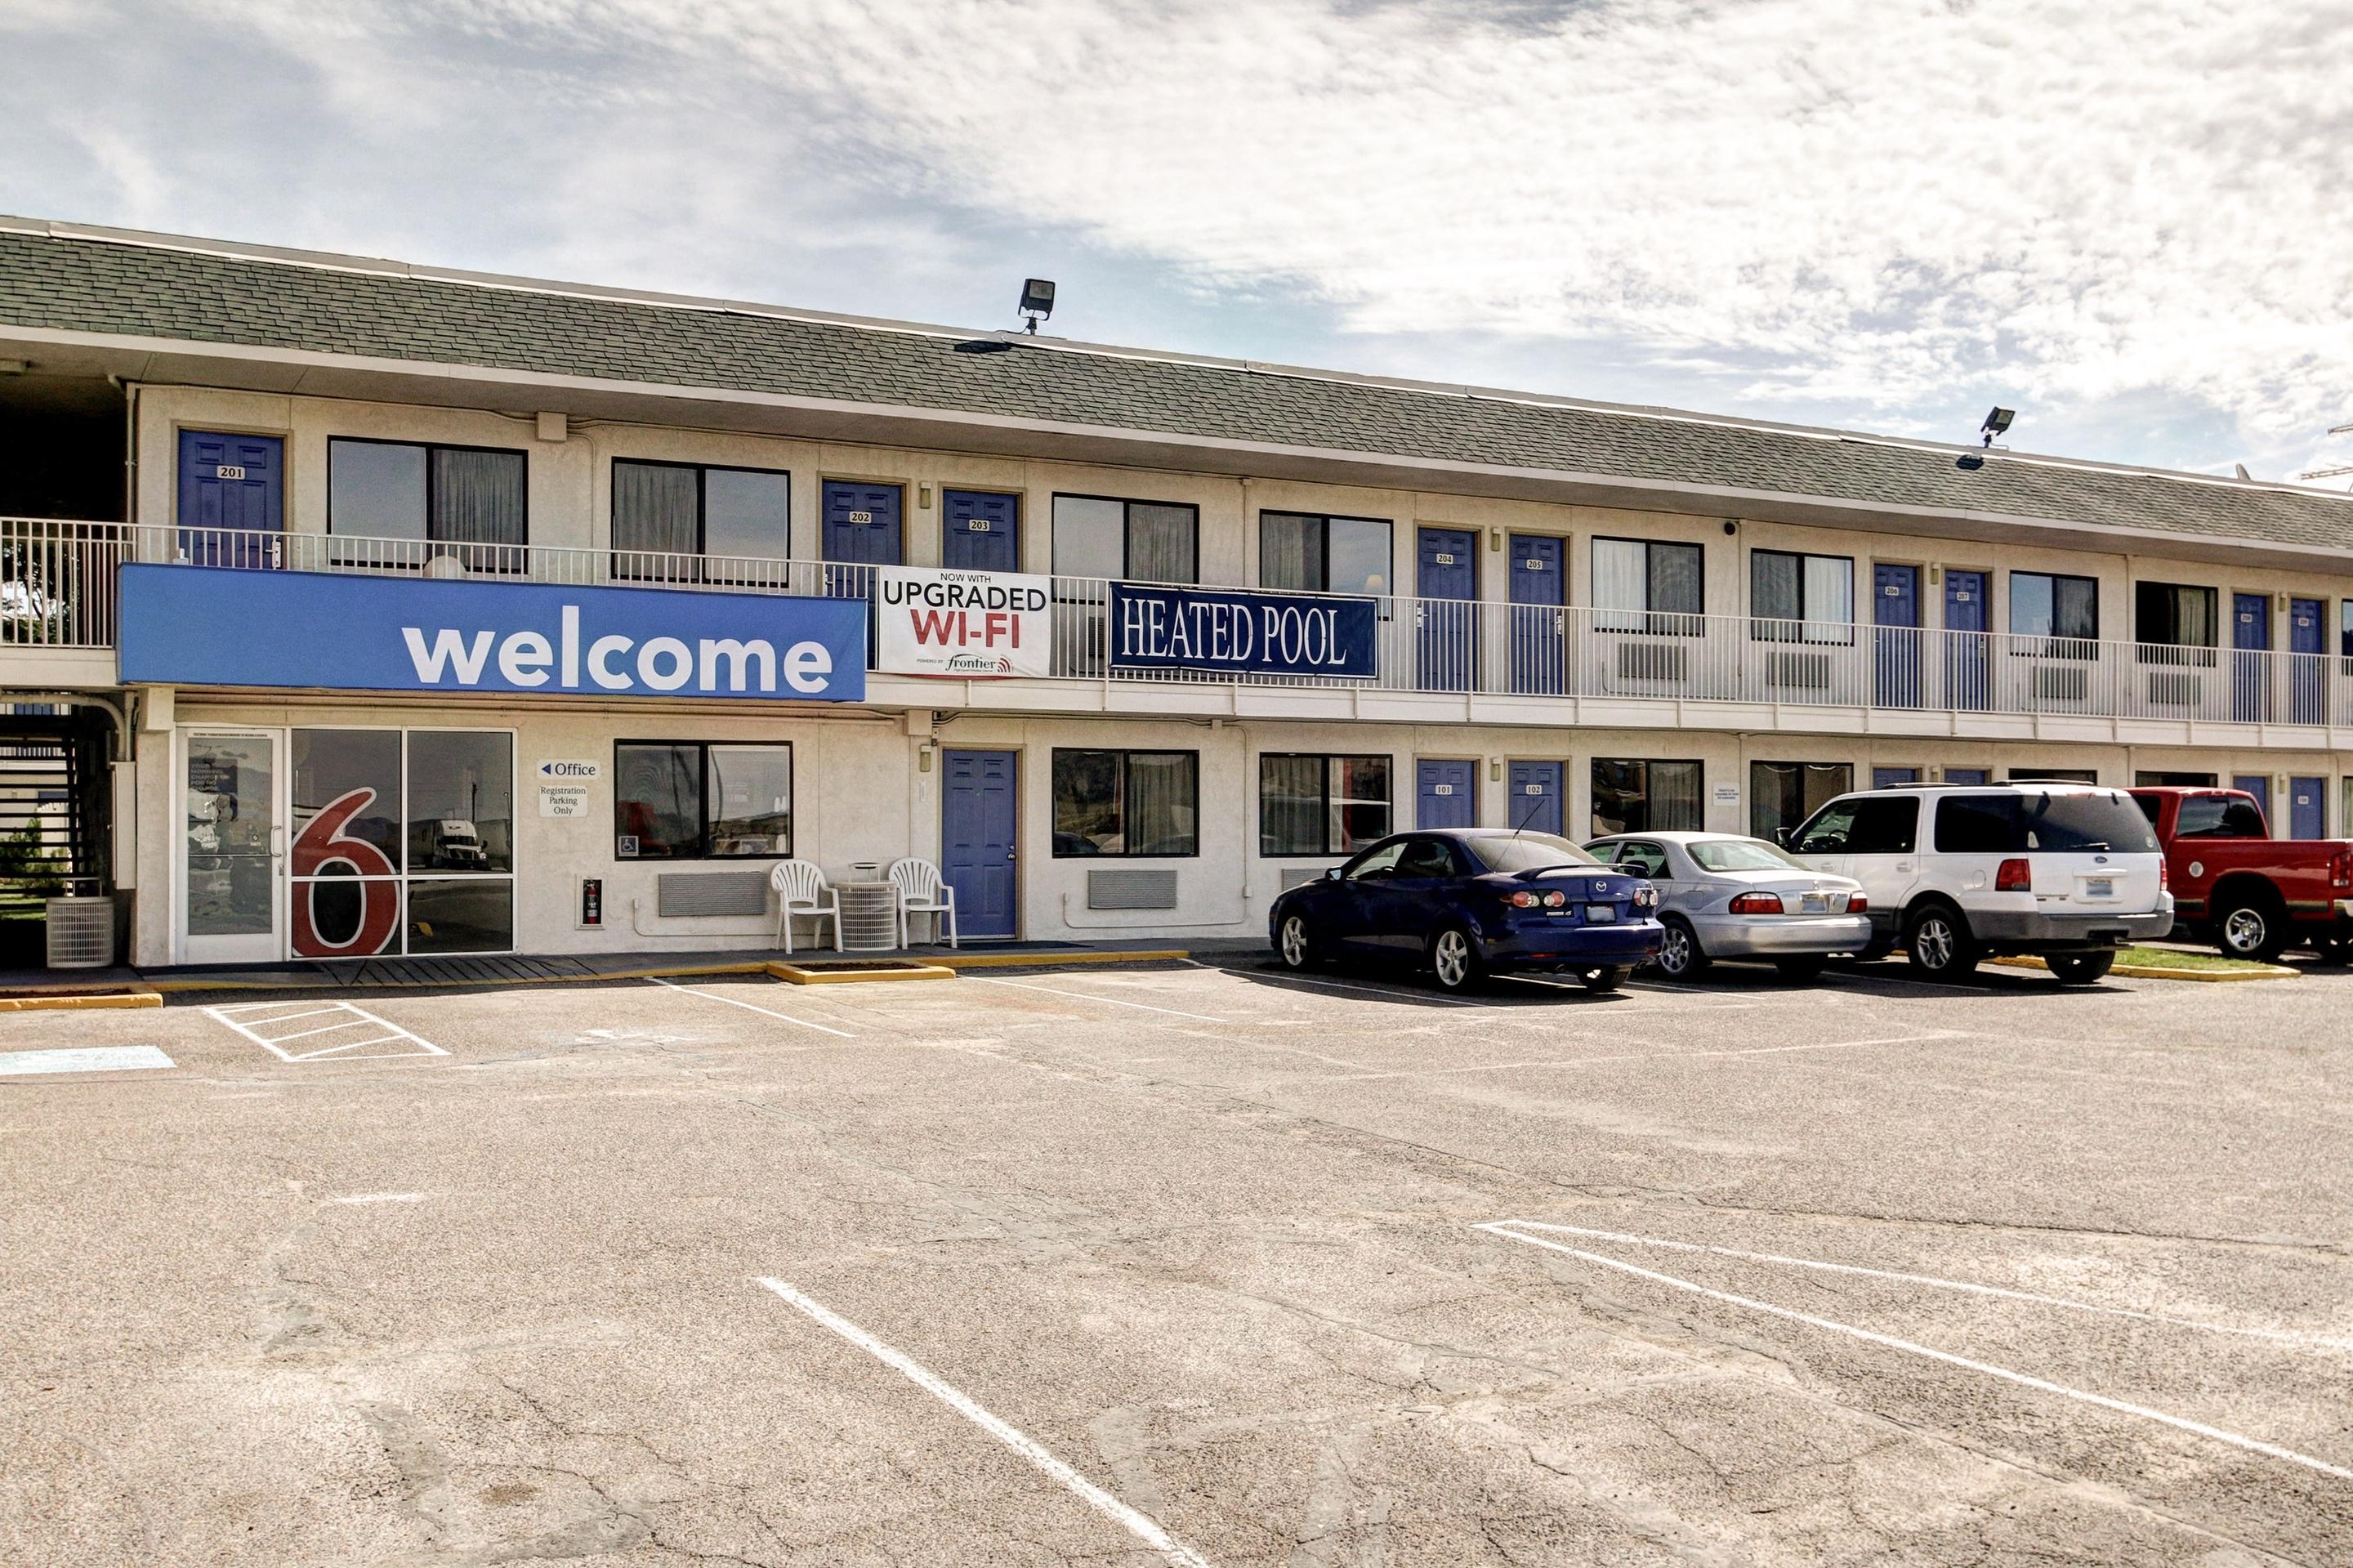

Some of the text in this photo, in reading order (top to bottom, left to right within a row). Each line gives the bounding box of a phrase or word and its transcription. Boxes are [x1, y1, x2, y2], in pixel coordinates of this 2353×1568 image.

[221, 467, 241, 478] 201
[852, 512, 869, 522] 202
[971, 520, 988, 530] 203
[1438, 555, 1452, 563] 204
[1528, 561, 1542, 569] 205
[940, 573, 991, 583] NOW WITH
[884, 580, 1047, 611] UPGRADED
[909, 609, 1020, 649] WI-FI
[1121, 597, 1347, 665] HEATED POOL
[401, 605, 833, 694] welcome
[945, 653, 996, 671] frontier
[555, 762, 596, 775] Office
[541, 787, 586, 796] Registration
[549, 797, 578, 806] Parking
[553, 806, 573, 815] Only
[292, 787, 401, 957] 6
